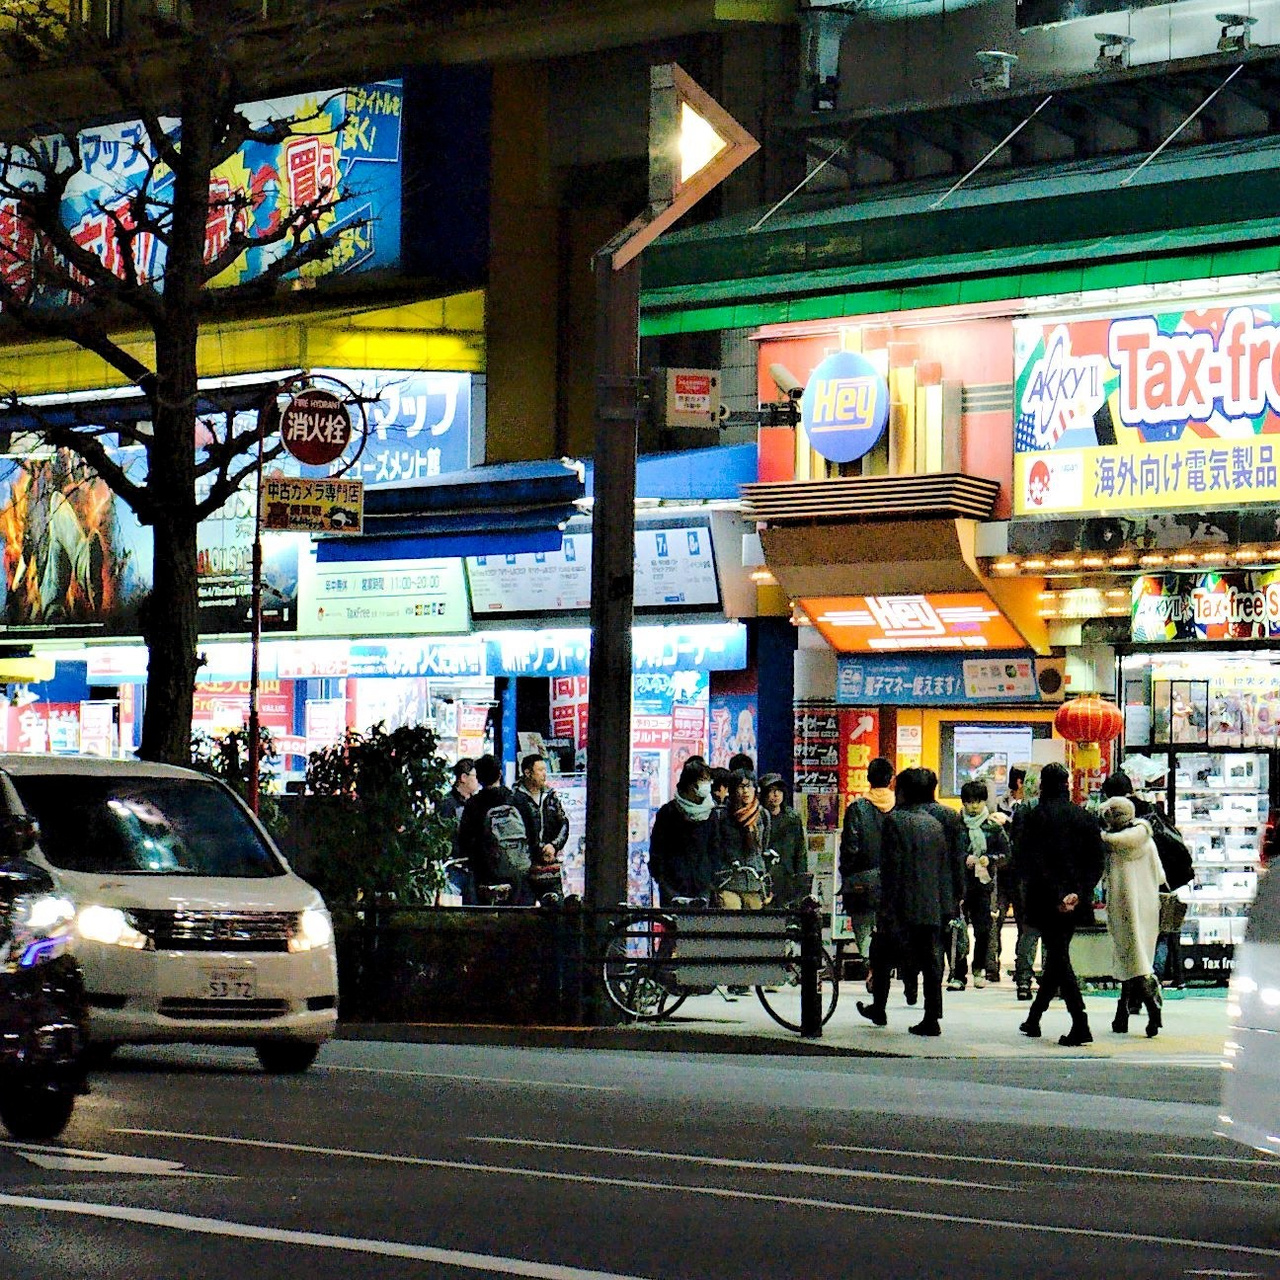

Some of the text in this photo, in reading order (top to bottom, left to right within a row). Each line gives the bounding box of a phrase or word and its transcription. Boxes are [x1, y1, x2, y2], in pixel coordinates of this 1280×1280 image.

[811, 375, 878, 433] Hey
[287, 411, 347, 445] 消火栓
[1094, 444, 1277, 497] 海外向け電気製品
[268, 482, 360, 504] 中古カメラ専門店
[863, 594, 947, 637] Hey
[1202, 955, 1220, 970] Tax
